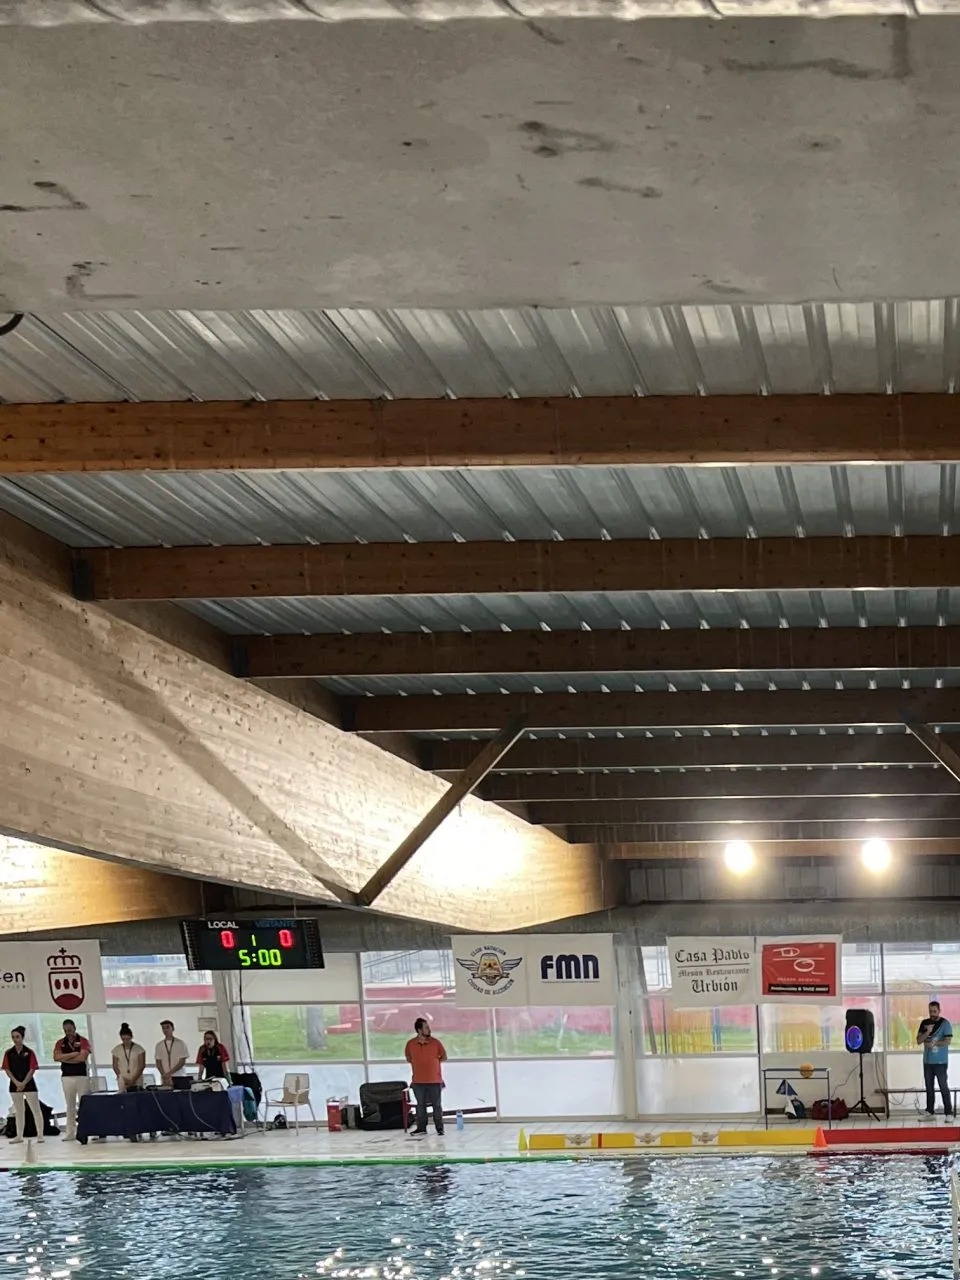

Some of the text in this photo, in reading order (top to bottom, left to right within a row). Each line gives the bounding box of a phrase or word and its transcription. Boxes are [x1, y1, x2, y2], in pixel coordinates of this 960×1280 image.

[208, 920, 239, 929] LOCAL
[220, 930, 235, 949] 0
[278, 929, 293, 948] 0
[238, 949, 282, 966] 5:00
[675, 947, 750, 963] Casa Pablo
[691, 977, 738, 993] Urbión
